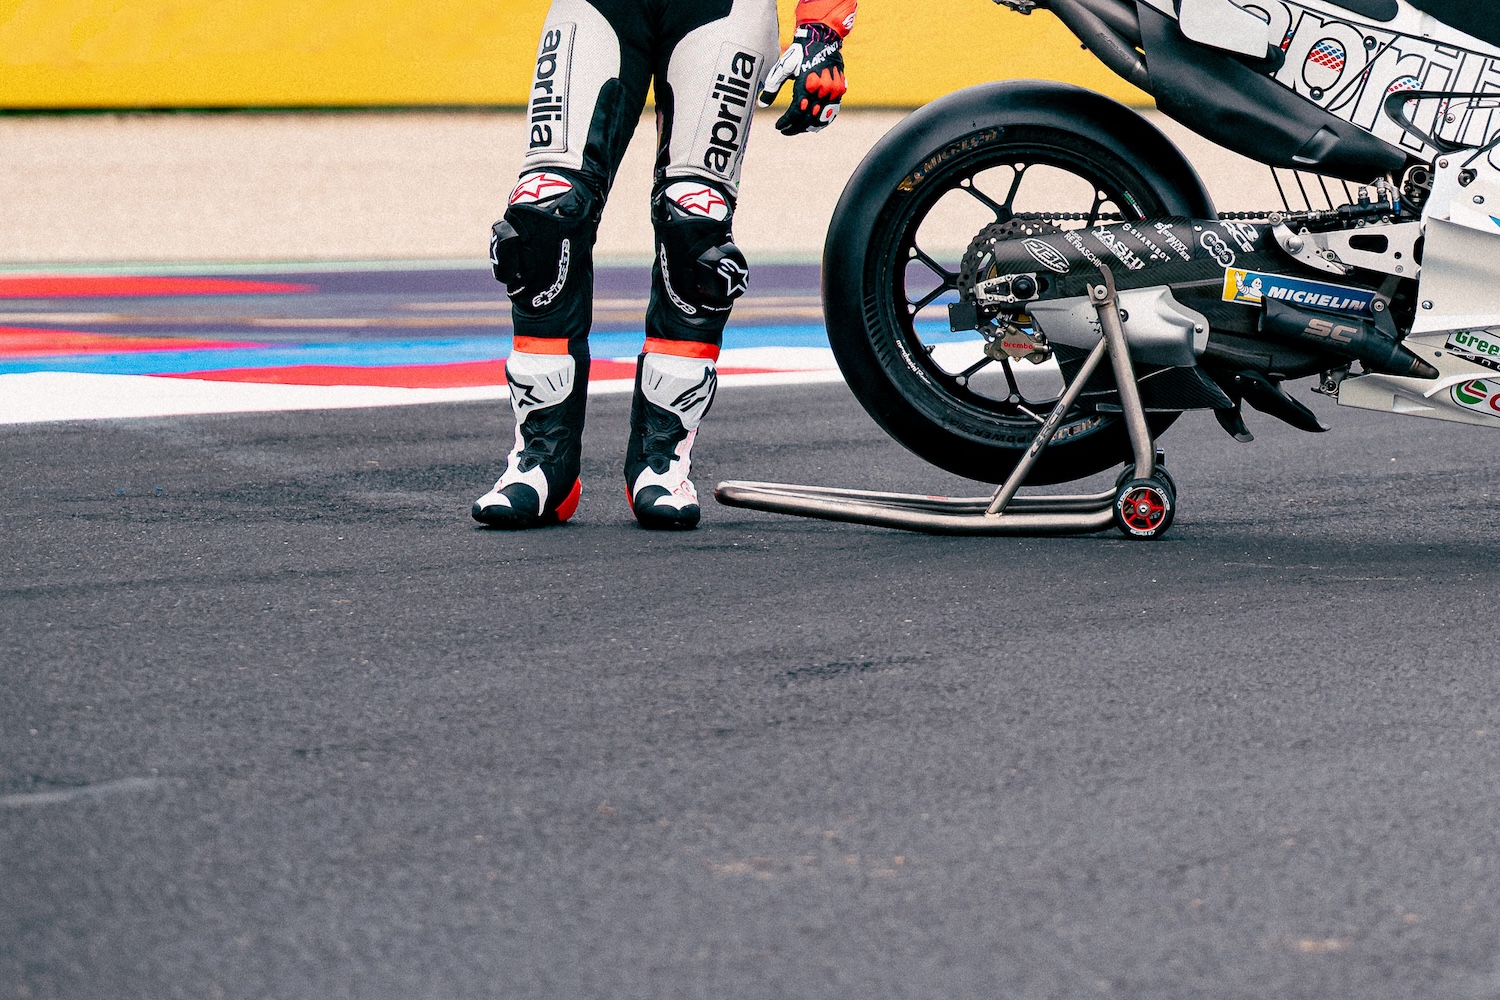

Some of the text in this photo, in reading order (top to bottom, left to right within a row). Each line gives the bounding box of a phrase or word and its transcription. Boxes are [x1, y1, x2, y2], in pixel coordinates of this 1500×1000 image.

[529, 29, 562, 149] aprilia
[704, 50, 756, 174] aprilia
[1072, 239, 1102, 268] FRASCHIN
[1099, 225, 1146, 270] YASHI
[1130, 228, 1171, 263] SHAREBOT
[1163, 229, 1189, 252] SPRINT
[1267, 286, 1367, 311] MICHELIN
[1304, 318, 1358, 343] SC
[1003, 341, 1033, 350] brembo
[975, 428, 1027, 444] POWER
